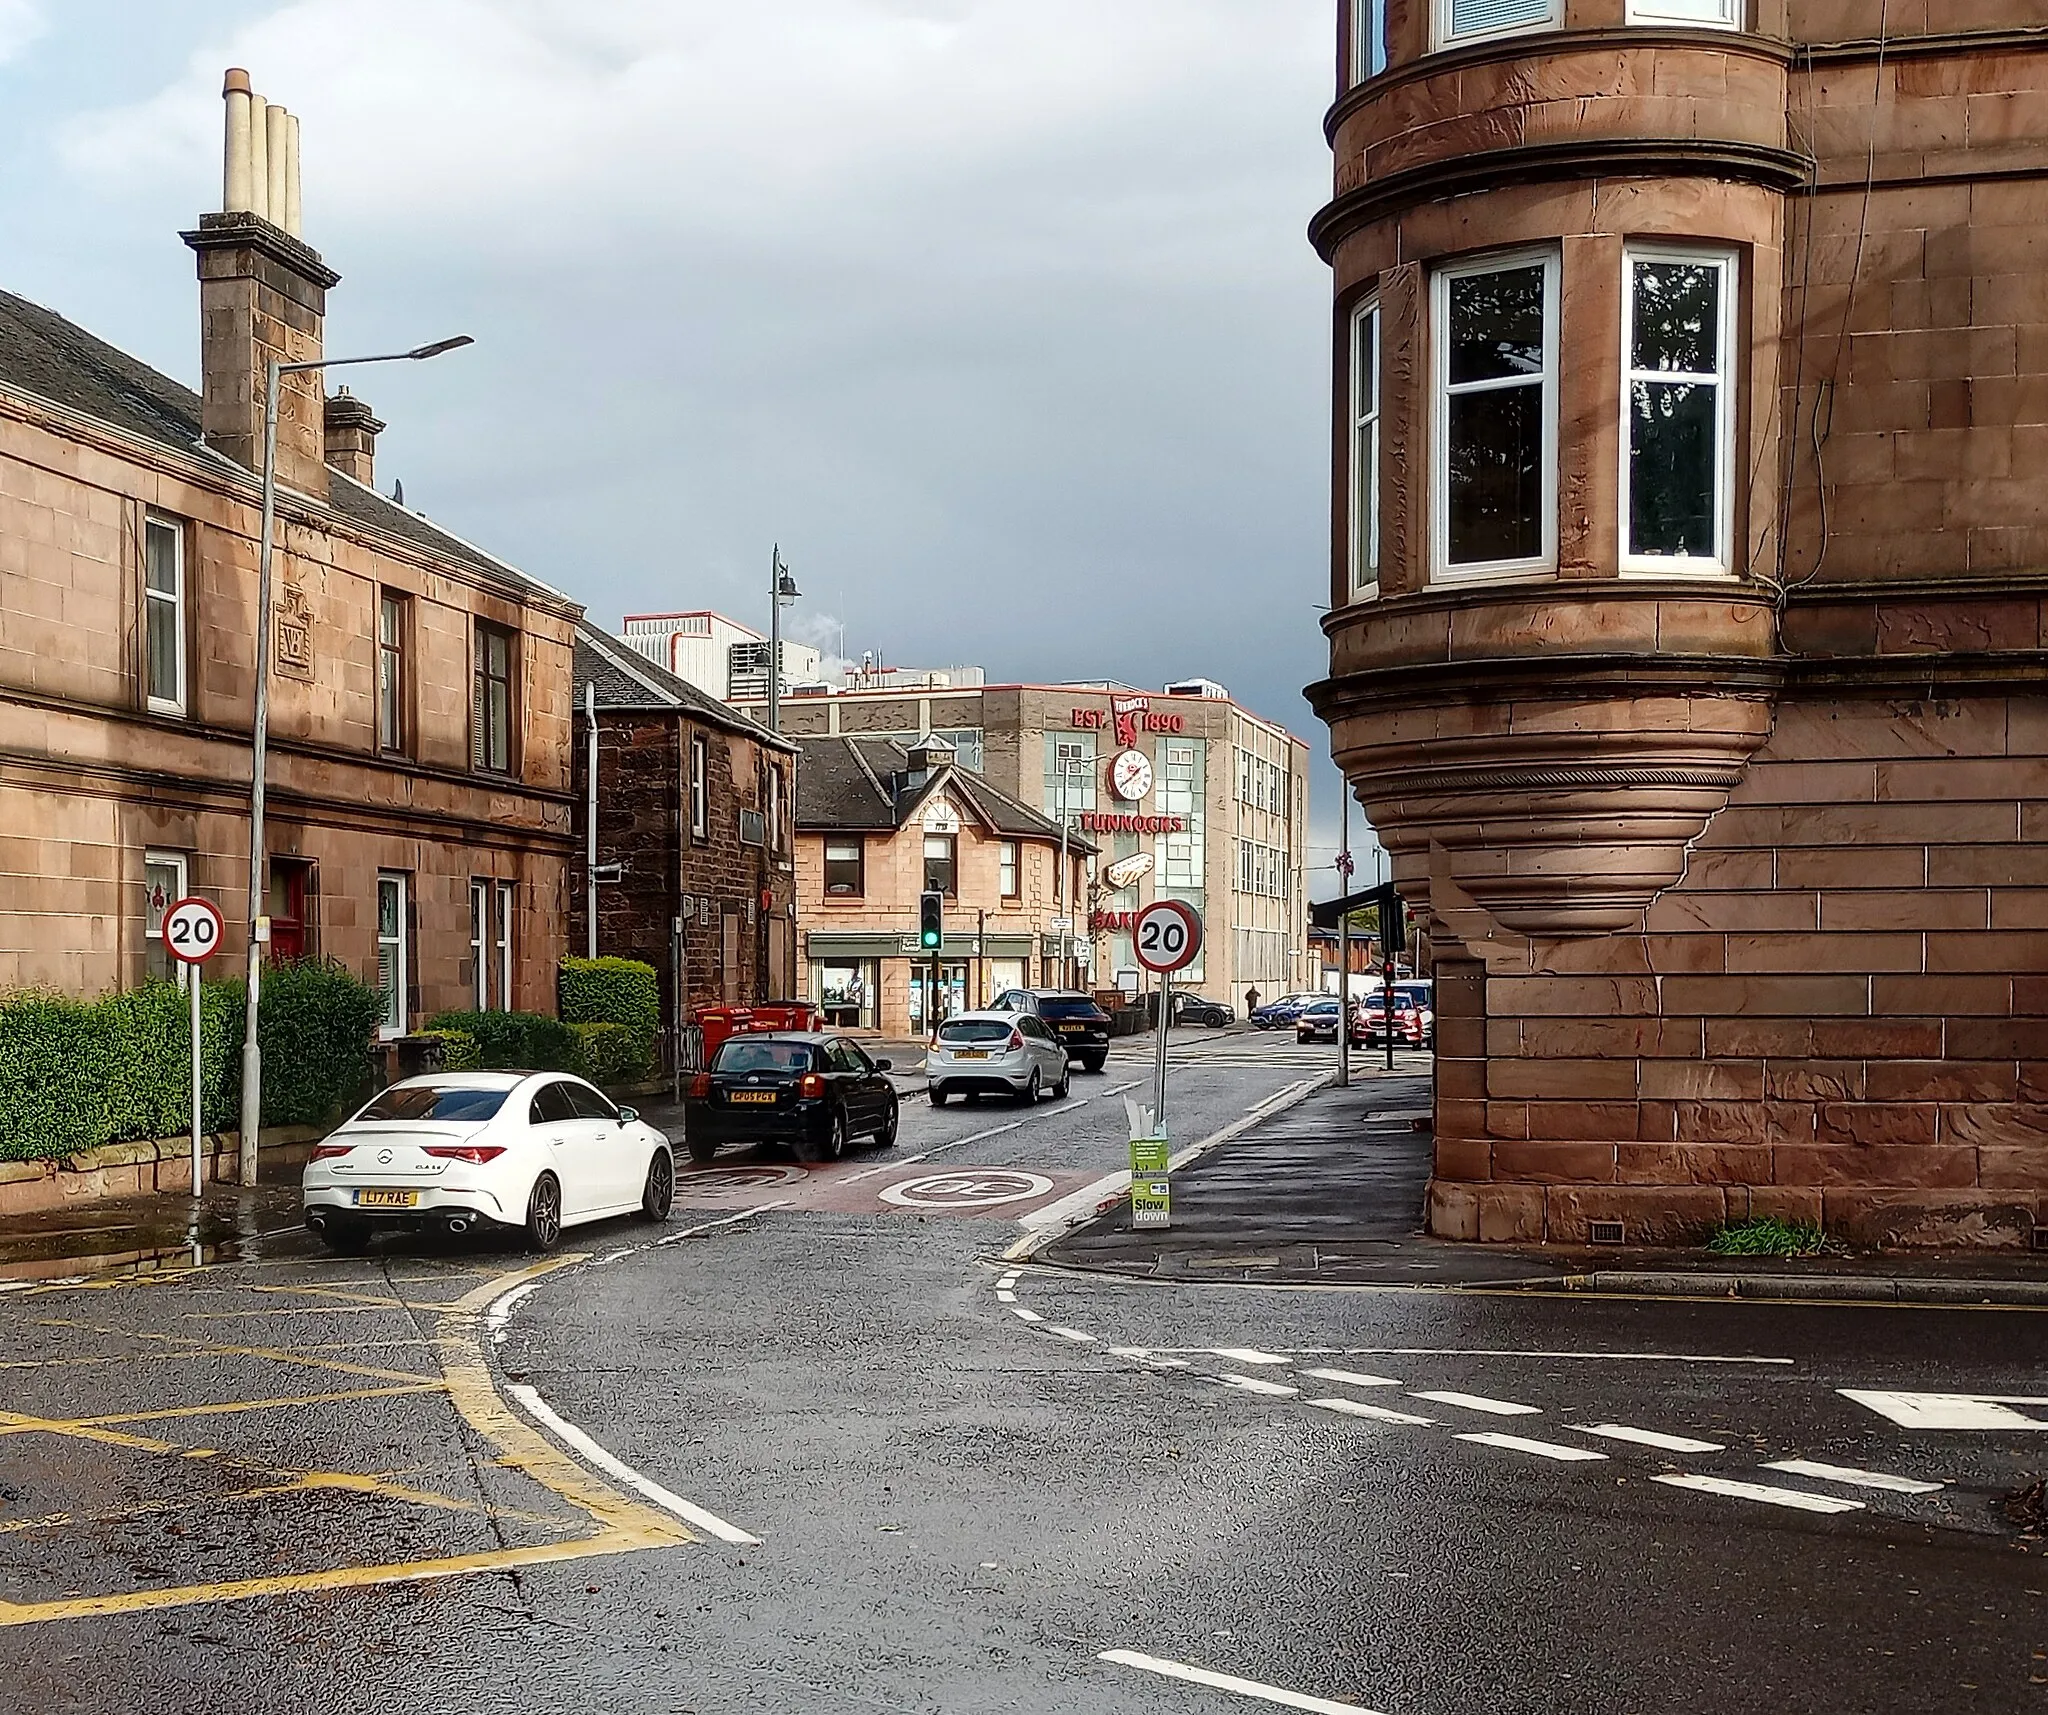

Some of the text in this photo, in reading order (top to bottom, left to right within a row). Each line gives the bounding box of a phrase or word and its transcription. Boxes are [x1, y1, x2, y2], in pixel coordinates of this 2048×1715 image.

[1142, 712, 1185, 733] 1890
[172, 918, 214, 943] 20
[1141, 922, 1184, 953] 20
[387, 1191, 410, 1204] RAE
[1135, 1199, 1164, 1210] Slow
[1135, 1210, 1168, 1222] down
